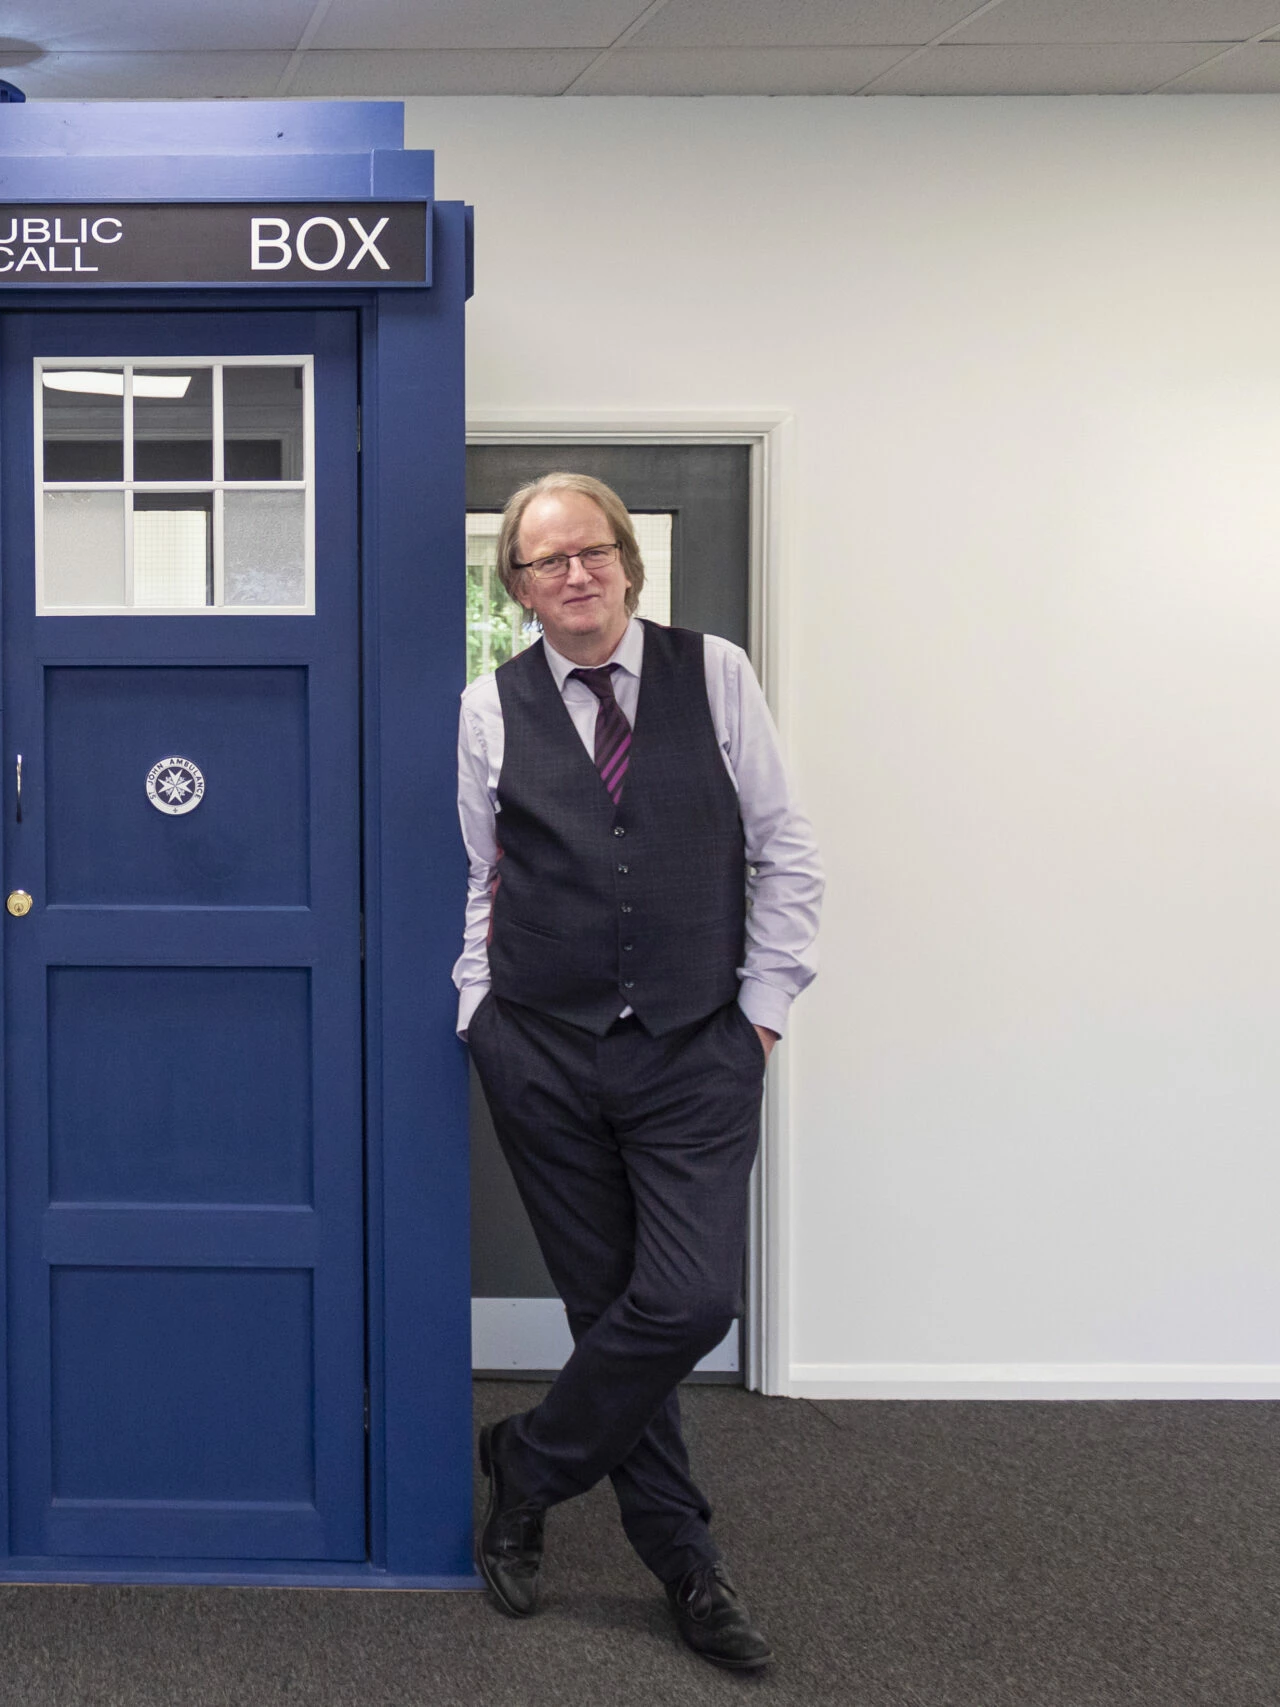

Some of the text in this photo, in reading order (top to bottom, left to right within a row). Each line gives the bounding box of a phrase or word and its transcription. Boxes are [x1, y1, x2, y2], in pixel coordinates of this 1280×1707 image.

[250, 217, 391, 270] BOX
[148, 763, 164, 785] JOHN
[170, 759, 204, 799] AMBULANCE
